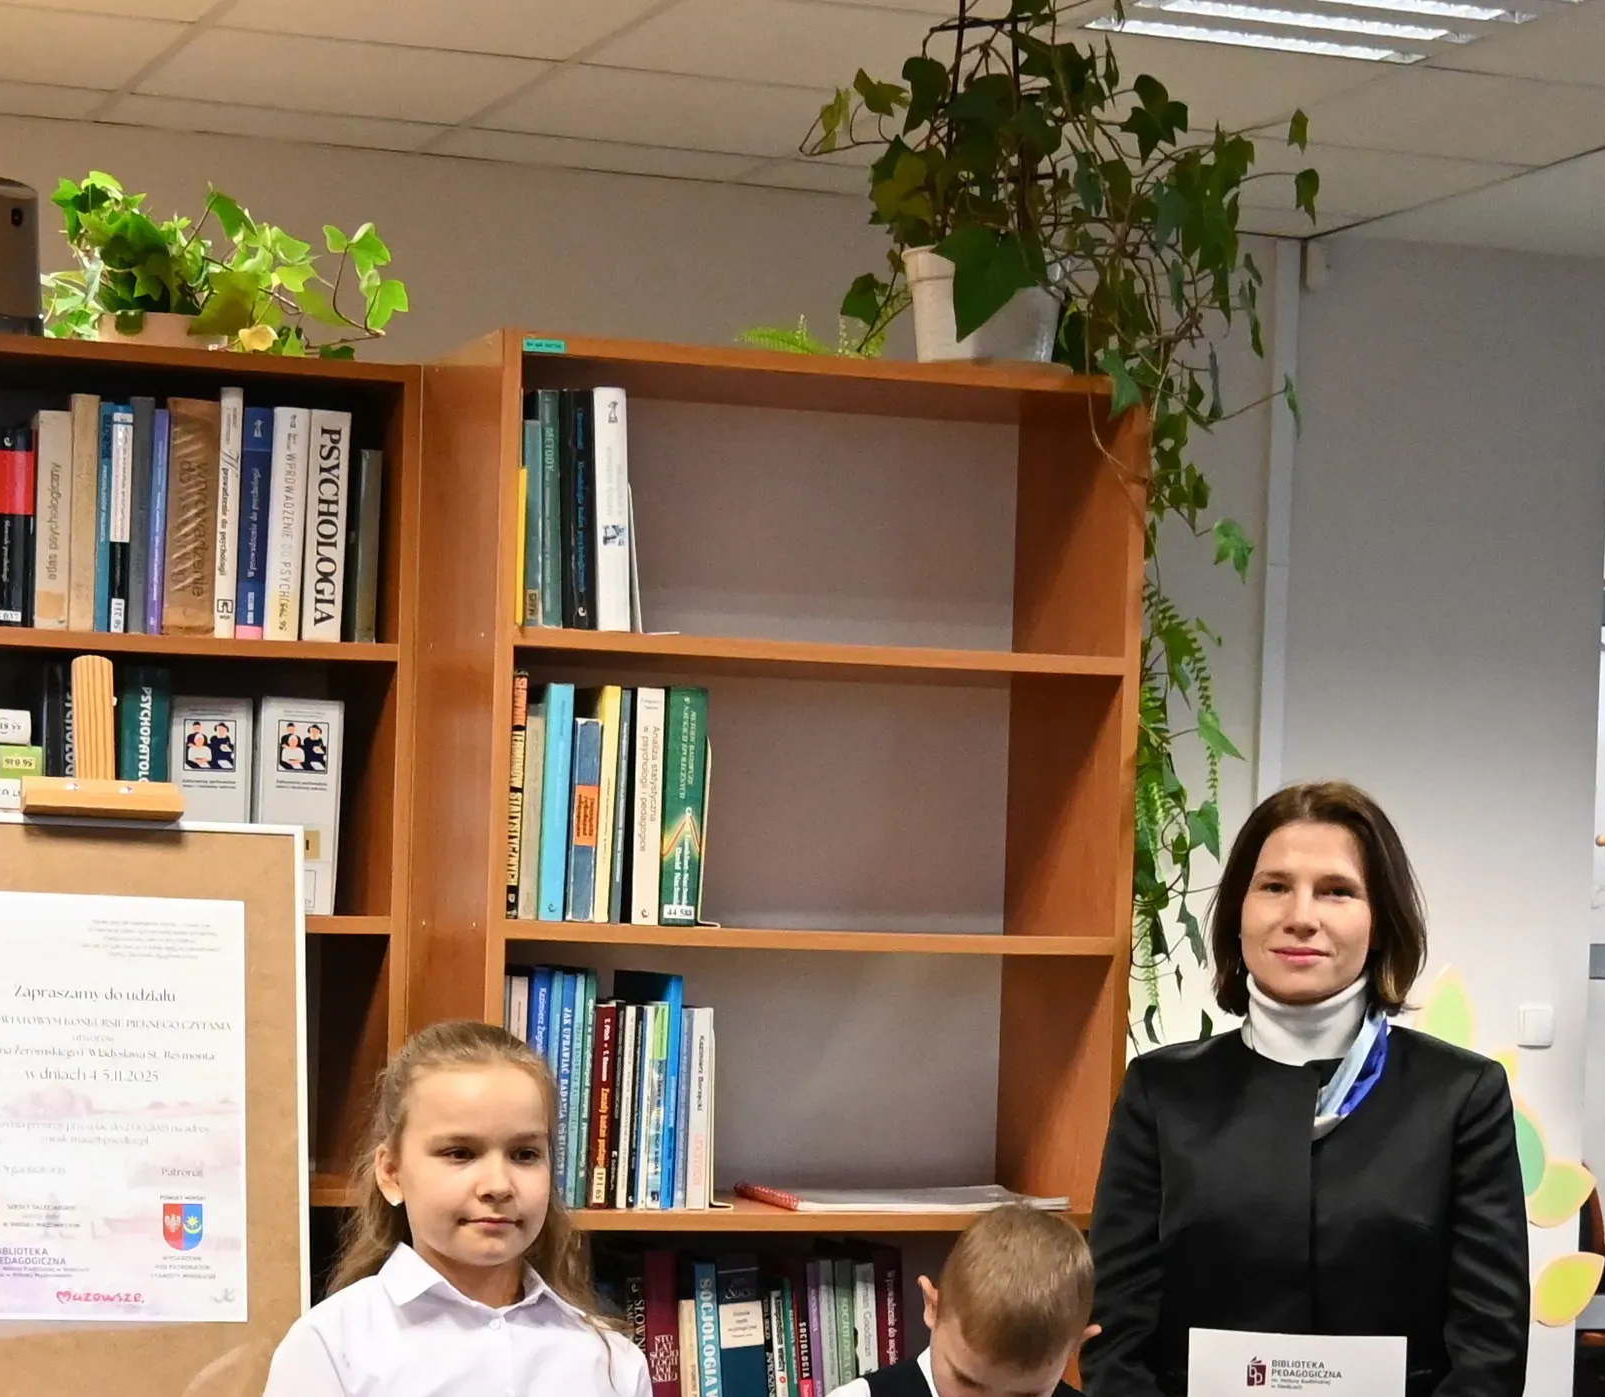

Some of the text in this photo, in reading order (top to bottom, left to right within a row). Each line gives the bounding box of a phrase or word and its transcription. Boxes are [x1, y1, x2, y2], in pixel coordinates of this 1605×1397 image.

[544, 427, 554, 471] METODY
[280, 453, 298, 539] WPROWADZENIE
[48, 462, 61, 581] atlas psychologiczny
[220, 520, 228, 531] do
[312, 426, 342, 626] PSYCHOLOGIA
[218, 532, 228, 576] psychologii
[639, 736, 650, 789] psychologii
[648, 725, 661, 822] Analiza statystyczna
[506, 677, 529, 886] SŁOWNIK TERMINÓW STATYSTYCZNYCH
[637, 797, 647, 852] pedagogice
[674, 847, 682, 870] David
[14, 985, 176, 1003] Zapraszamy do udziału
[537, 988, 547, 1025] Kazimierz
[181, 1021, 231, 1031] CZYTANIA
[563, 1008, 572, 1025] JAK
[603, 1024, 611, 1041] Pilch
[14, 1044, 79, 1059] Żeromskiego
[88, 1049, 145, 1060] Władysława
[164, 1051, 215, 1060] Reymonta
[561, 1028, 571, 1074] UPRAWIAĆ
[583, 1035, 592, 1086] pedagogiczne
[40, 1067, 87, 1081] dniach
[696, 1035, 705, 1111] Kazimierz Borzęcki
[558, 1079, 568, 1119] BADANIA
[598, 1087, 610, 1138] Zasady badań
[161, 1167, 204, 1177] Patronat
[886, 1270, 898, 1326] Wprowadzenie
[654, 1334, 673, 1343] STO
[700, 1278, 717, 1387] SOCJOLOGIA
[798, 1322, 810, 1378] SOCJOLOGIA
[863, 1312, 873, 1358] Goodman
[888, 1328, 897, 1337] do
[649, 1349, 678, 1360] SOCJO
[650, 1357, 678, 1367] LOGII
[655, 1366, 672, 1375] POL
[777, 1347, 786, 1373] wiedzy
[1271, 1359, 1325, 1370] BIBLIOTEKA
[652, 1374, 678, 1383] SKIEJ
[1271, 1369, 1342, 1379] PEDAGOGICZNA
